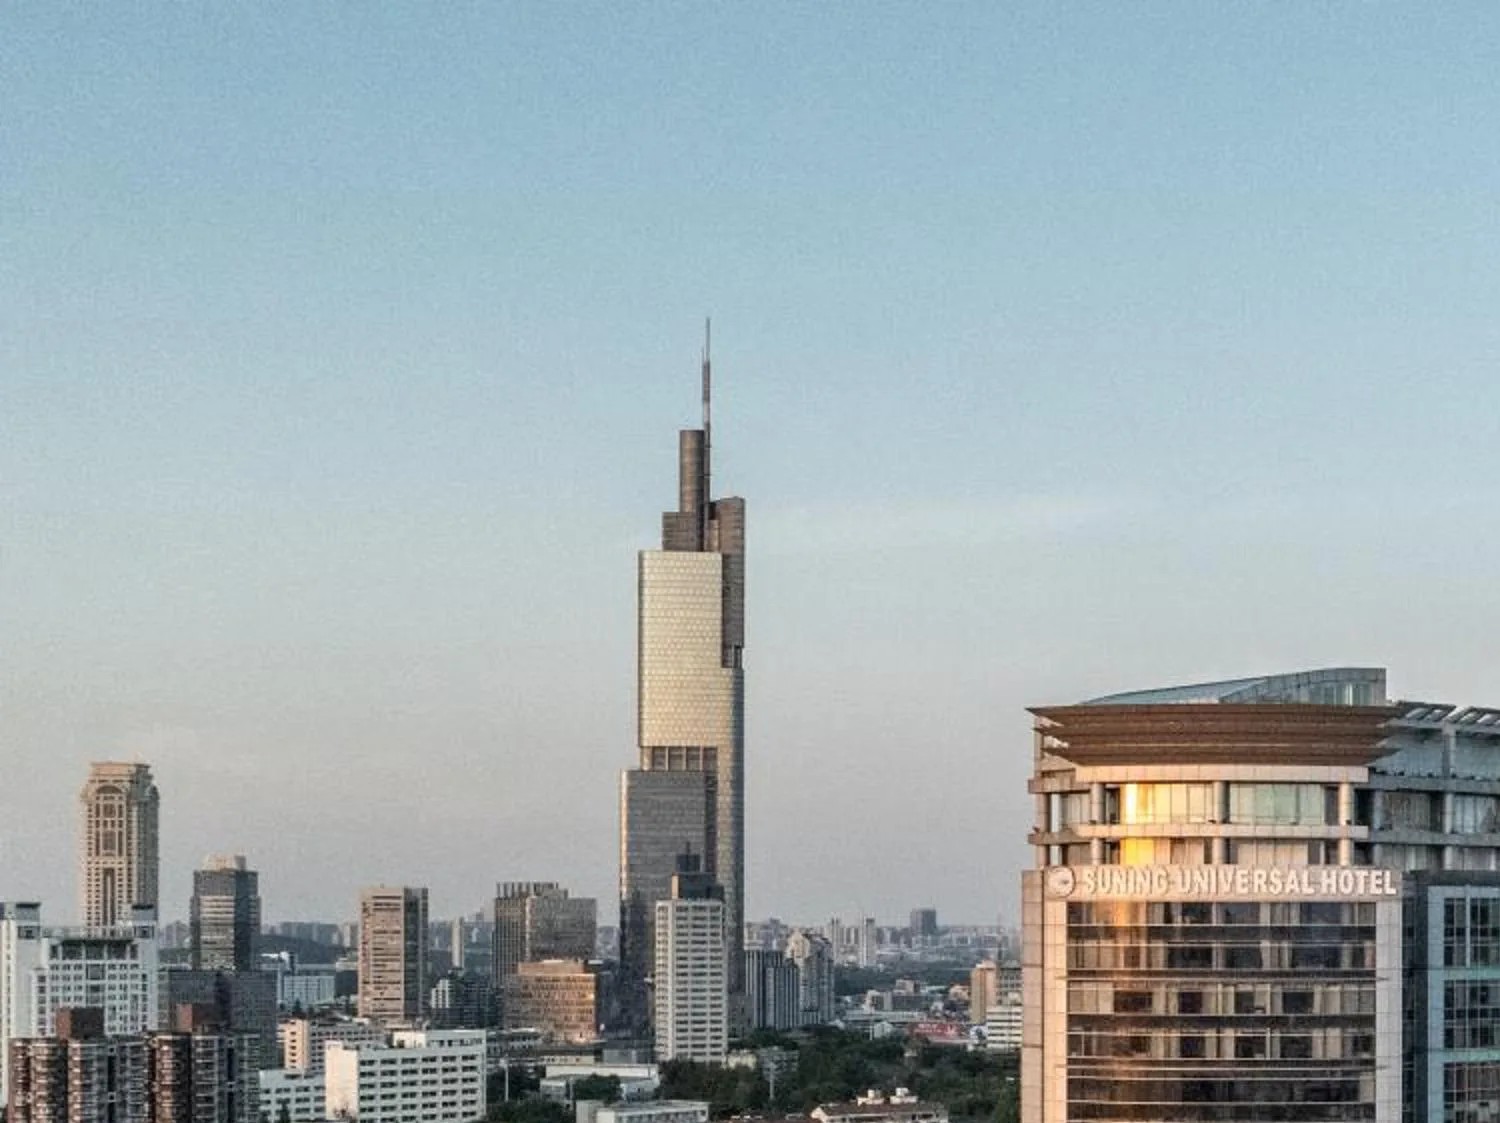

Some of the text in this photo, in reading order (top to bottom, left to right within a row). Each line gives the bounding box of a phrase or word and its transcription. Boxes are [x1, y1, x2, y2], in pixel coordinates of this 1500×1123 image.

[1083, 867, 1397, 895] SUNING UNIVERSAL HOTEL
